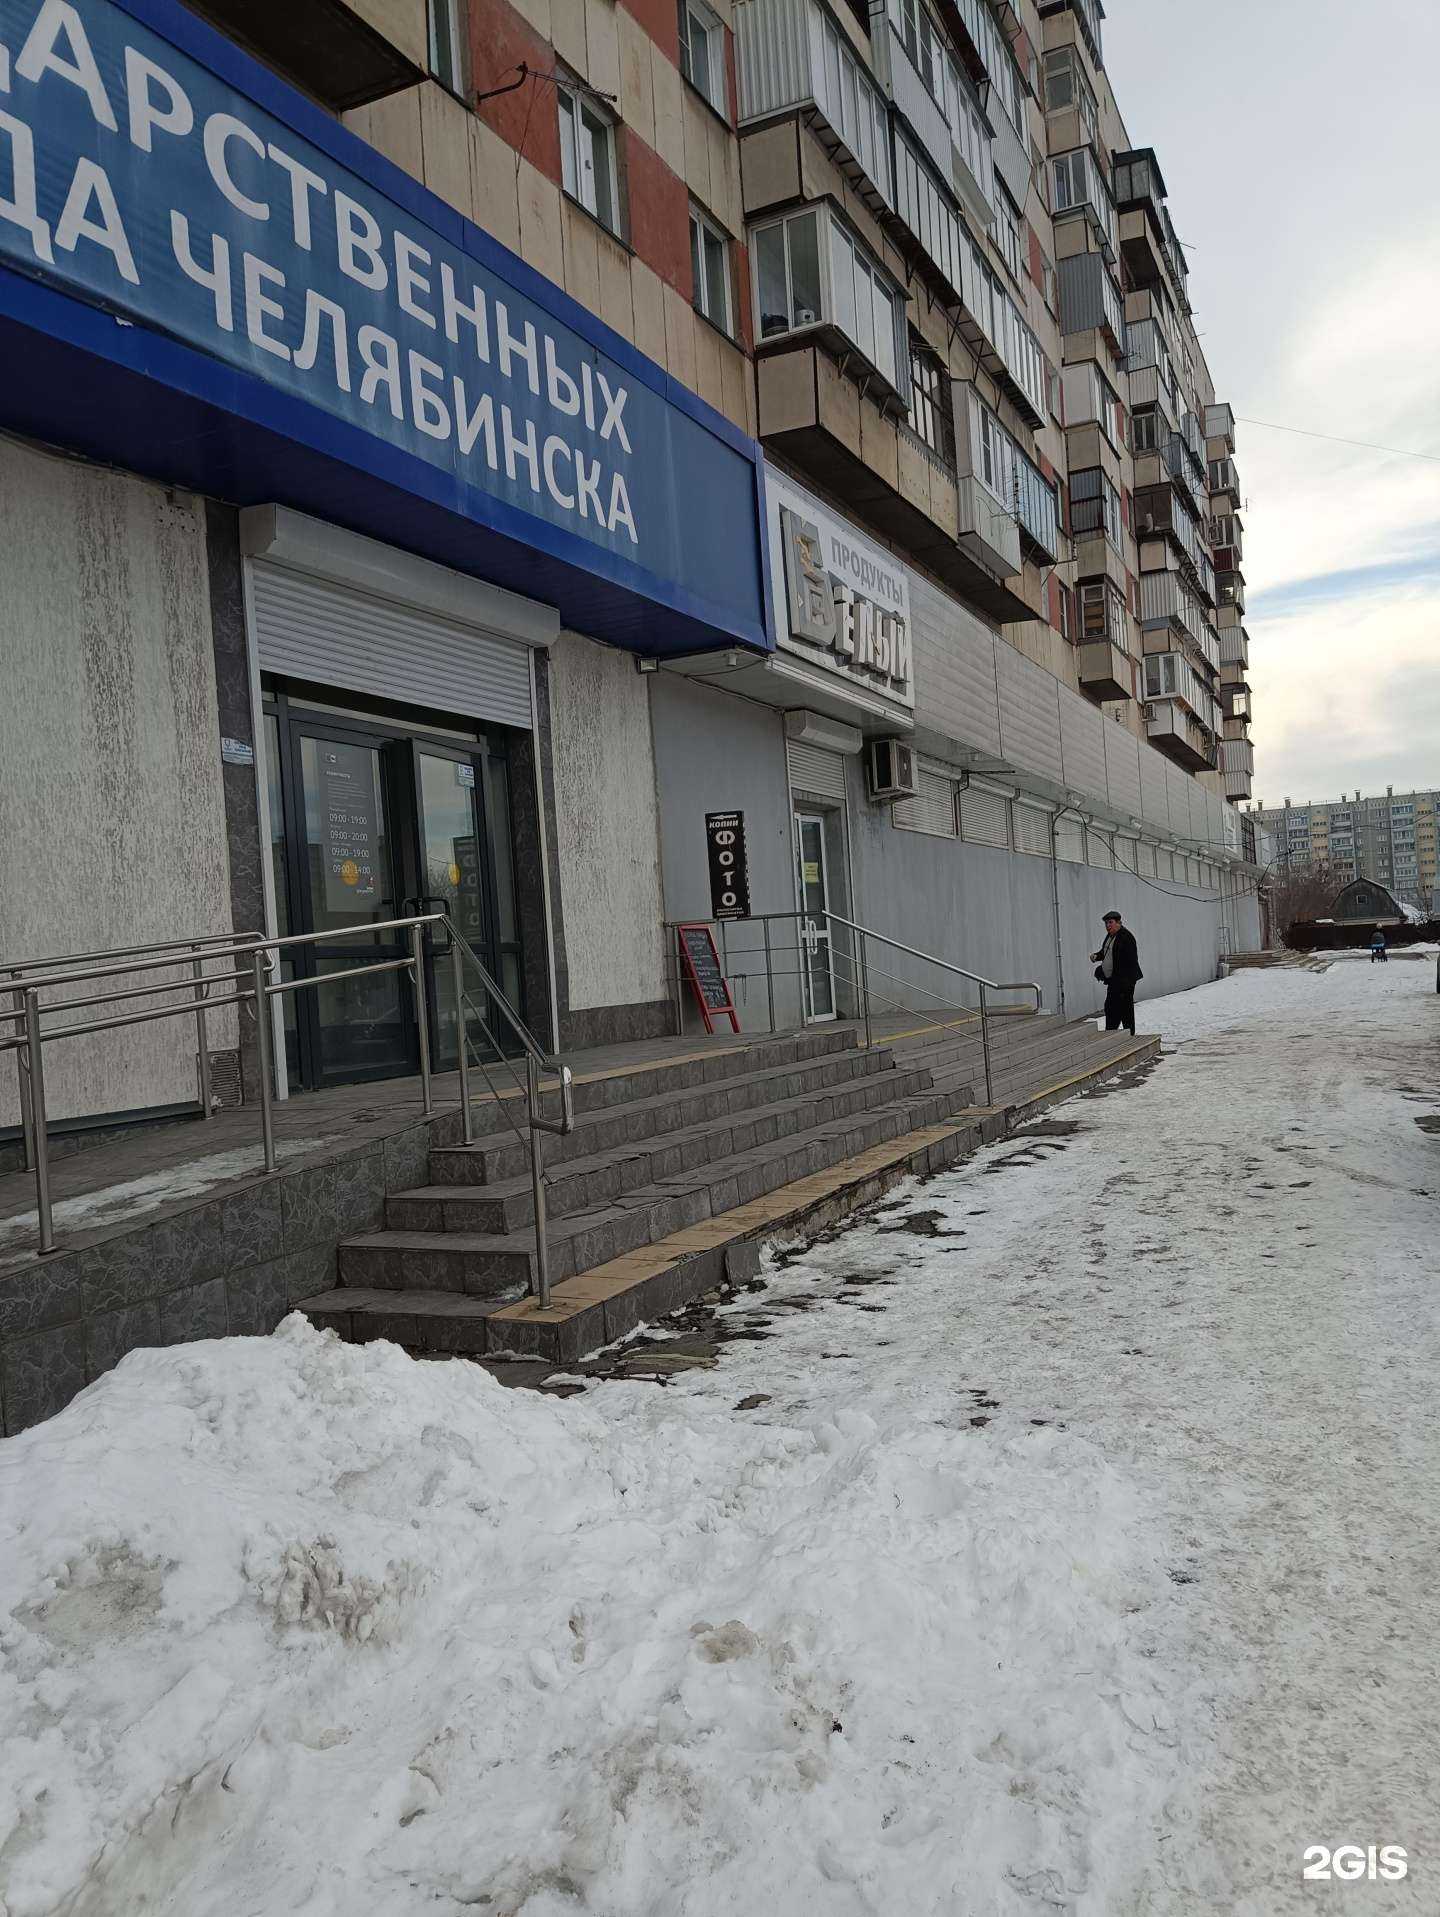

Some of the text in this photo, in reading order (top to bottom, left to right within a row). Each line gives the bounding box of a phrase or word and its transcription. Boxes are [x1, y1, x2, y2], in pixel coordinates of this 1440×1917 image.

[0, 0, 633, 454] АРСТВЕННЫХ
[170, 209, 639, 545] ЧЕЛЯБИНСКА
[830, 536, 904, 607] ПРОДУКТЫ
[715, 830, 737, 907] ФОТО
